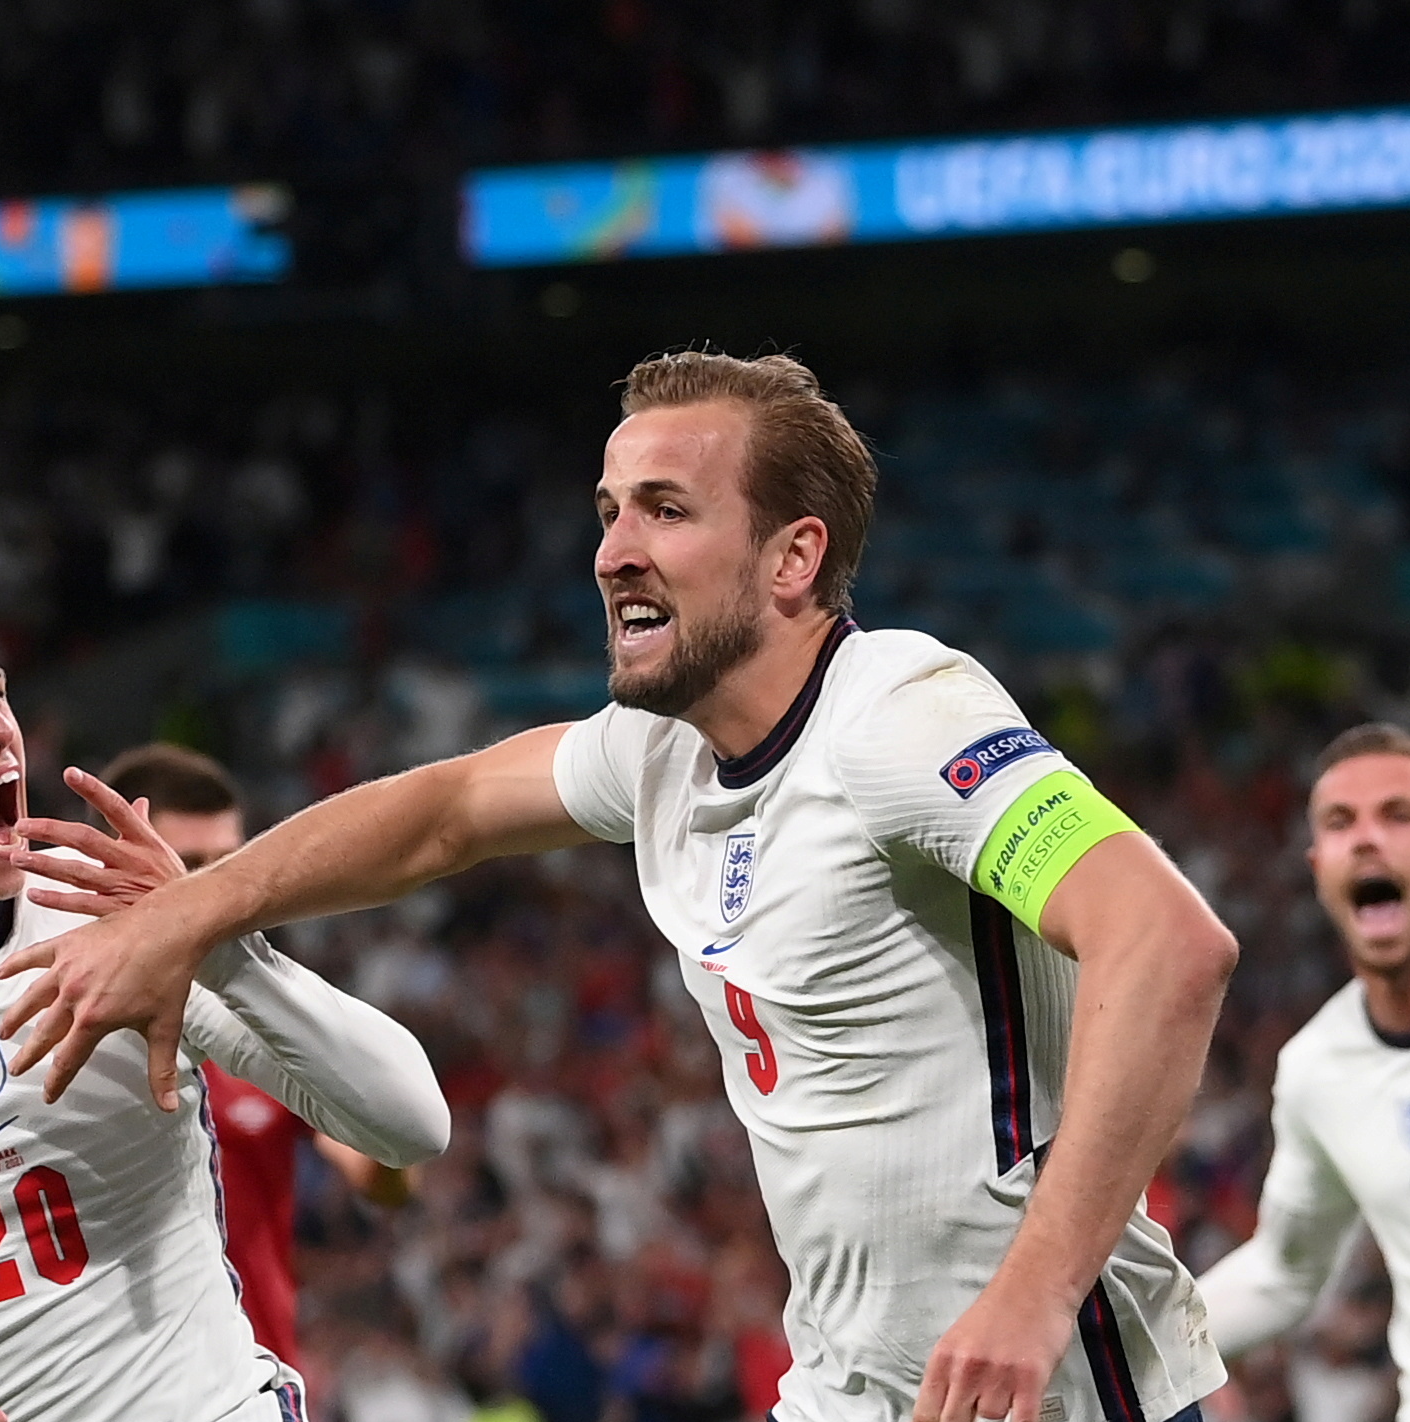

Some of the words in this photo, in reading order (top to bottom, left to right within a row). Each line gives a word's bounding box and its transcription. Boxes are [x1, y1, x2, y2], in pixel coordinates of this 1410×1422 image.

[894, 135, 1072, 232] UEFA
[1084, 122, 1277, 221] EURO
[1021, 811, 1082, 878] RESPECT
[1027, 791, 1072, 826] GAME
[724, 980, 778, 1096] 9
